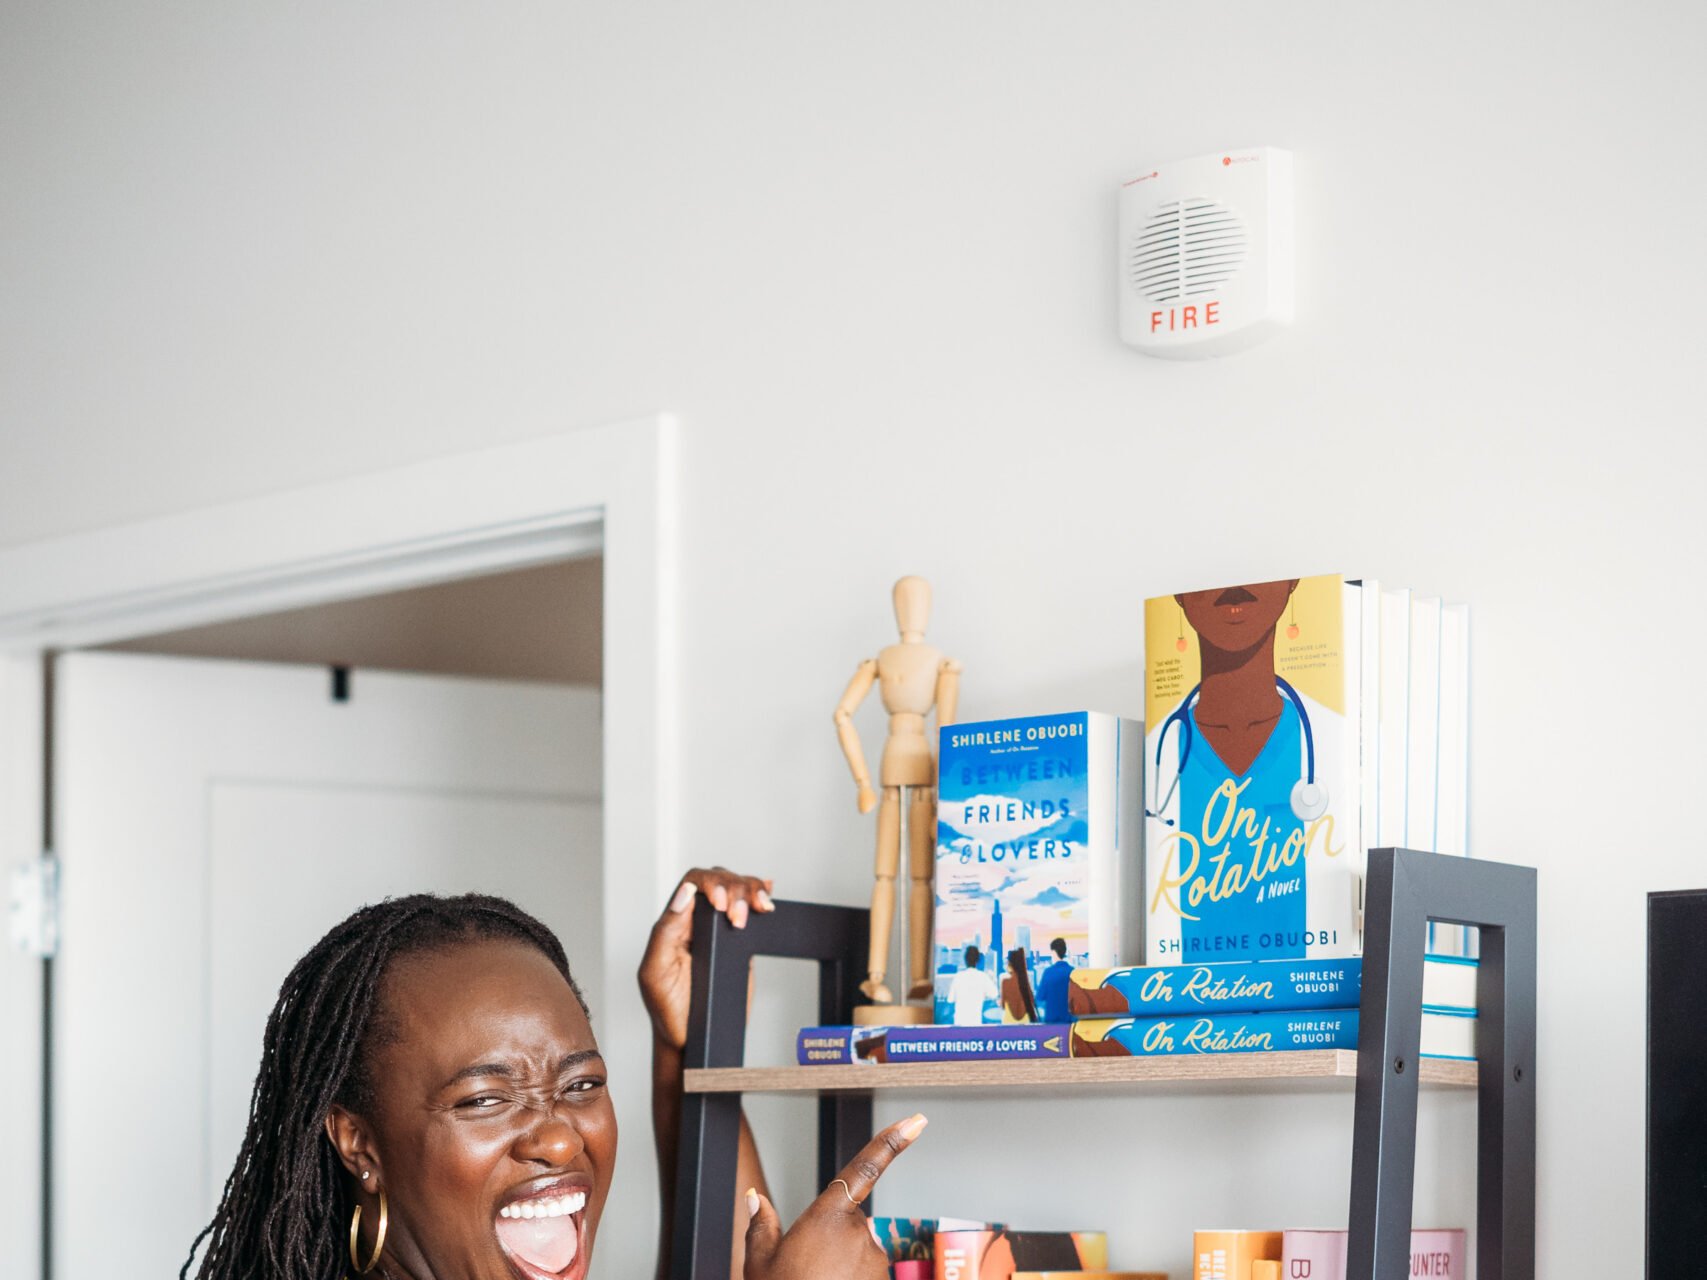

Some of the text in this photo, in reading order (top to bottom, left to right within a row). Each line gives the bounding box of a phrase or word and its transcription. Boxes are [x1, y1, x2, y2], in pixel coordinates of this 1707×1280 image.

[1151, 301, 1220, 333] FIRE
[952, 723, 1083, 748] SHIRLENE OBUOBI
[961, 759, 1073, 786] BETWEEN
[964, 798, 1070, 824] FRIENDS
[1202, 777, 1259, 847] On
[978, 838, 1072, 863] LOVERS
[1151, 814, 1345, 921] Rotation
[1256, 878, 1300, 903] A NOVEL
[1159, 930, 1337, 953] SHIRLENE OBUOBI
[1141, 967, 1274, 1004] On Rotation
[1290, 971, 1344, 982] SHIRLENE
[1295, 983, 1339, 993] OBUOBI
[1142, 1018, 1273, 1054] On Rotation
[1287, 1021, 1341, 1032] SHIRLENE
[1292, 1033, 1335, 1044] OBUOBI
[803, 1038, 846, 1049] SHIRLENE
[890, 1042, 937, 1053] BETWEEN
[940, 1040, 983, 1052] FRIENDS
[996, 1039, 1036, 1051] LOVERS
[1409, 1253, 1450, 1276] UNTER
